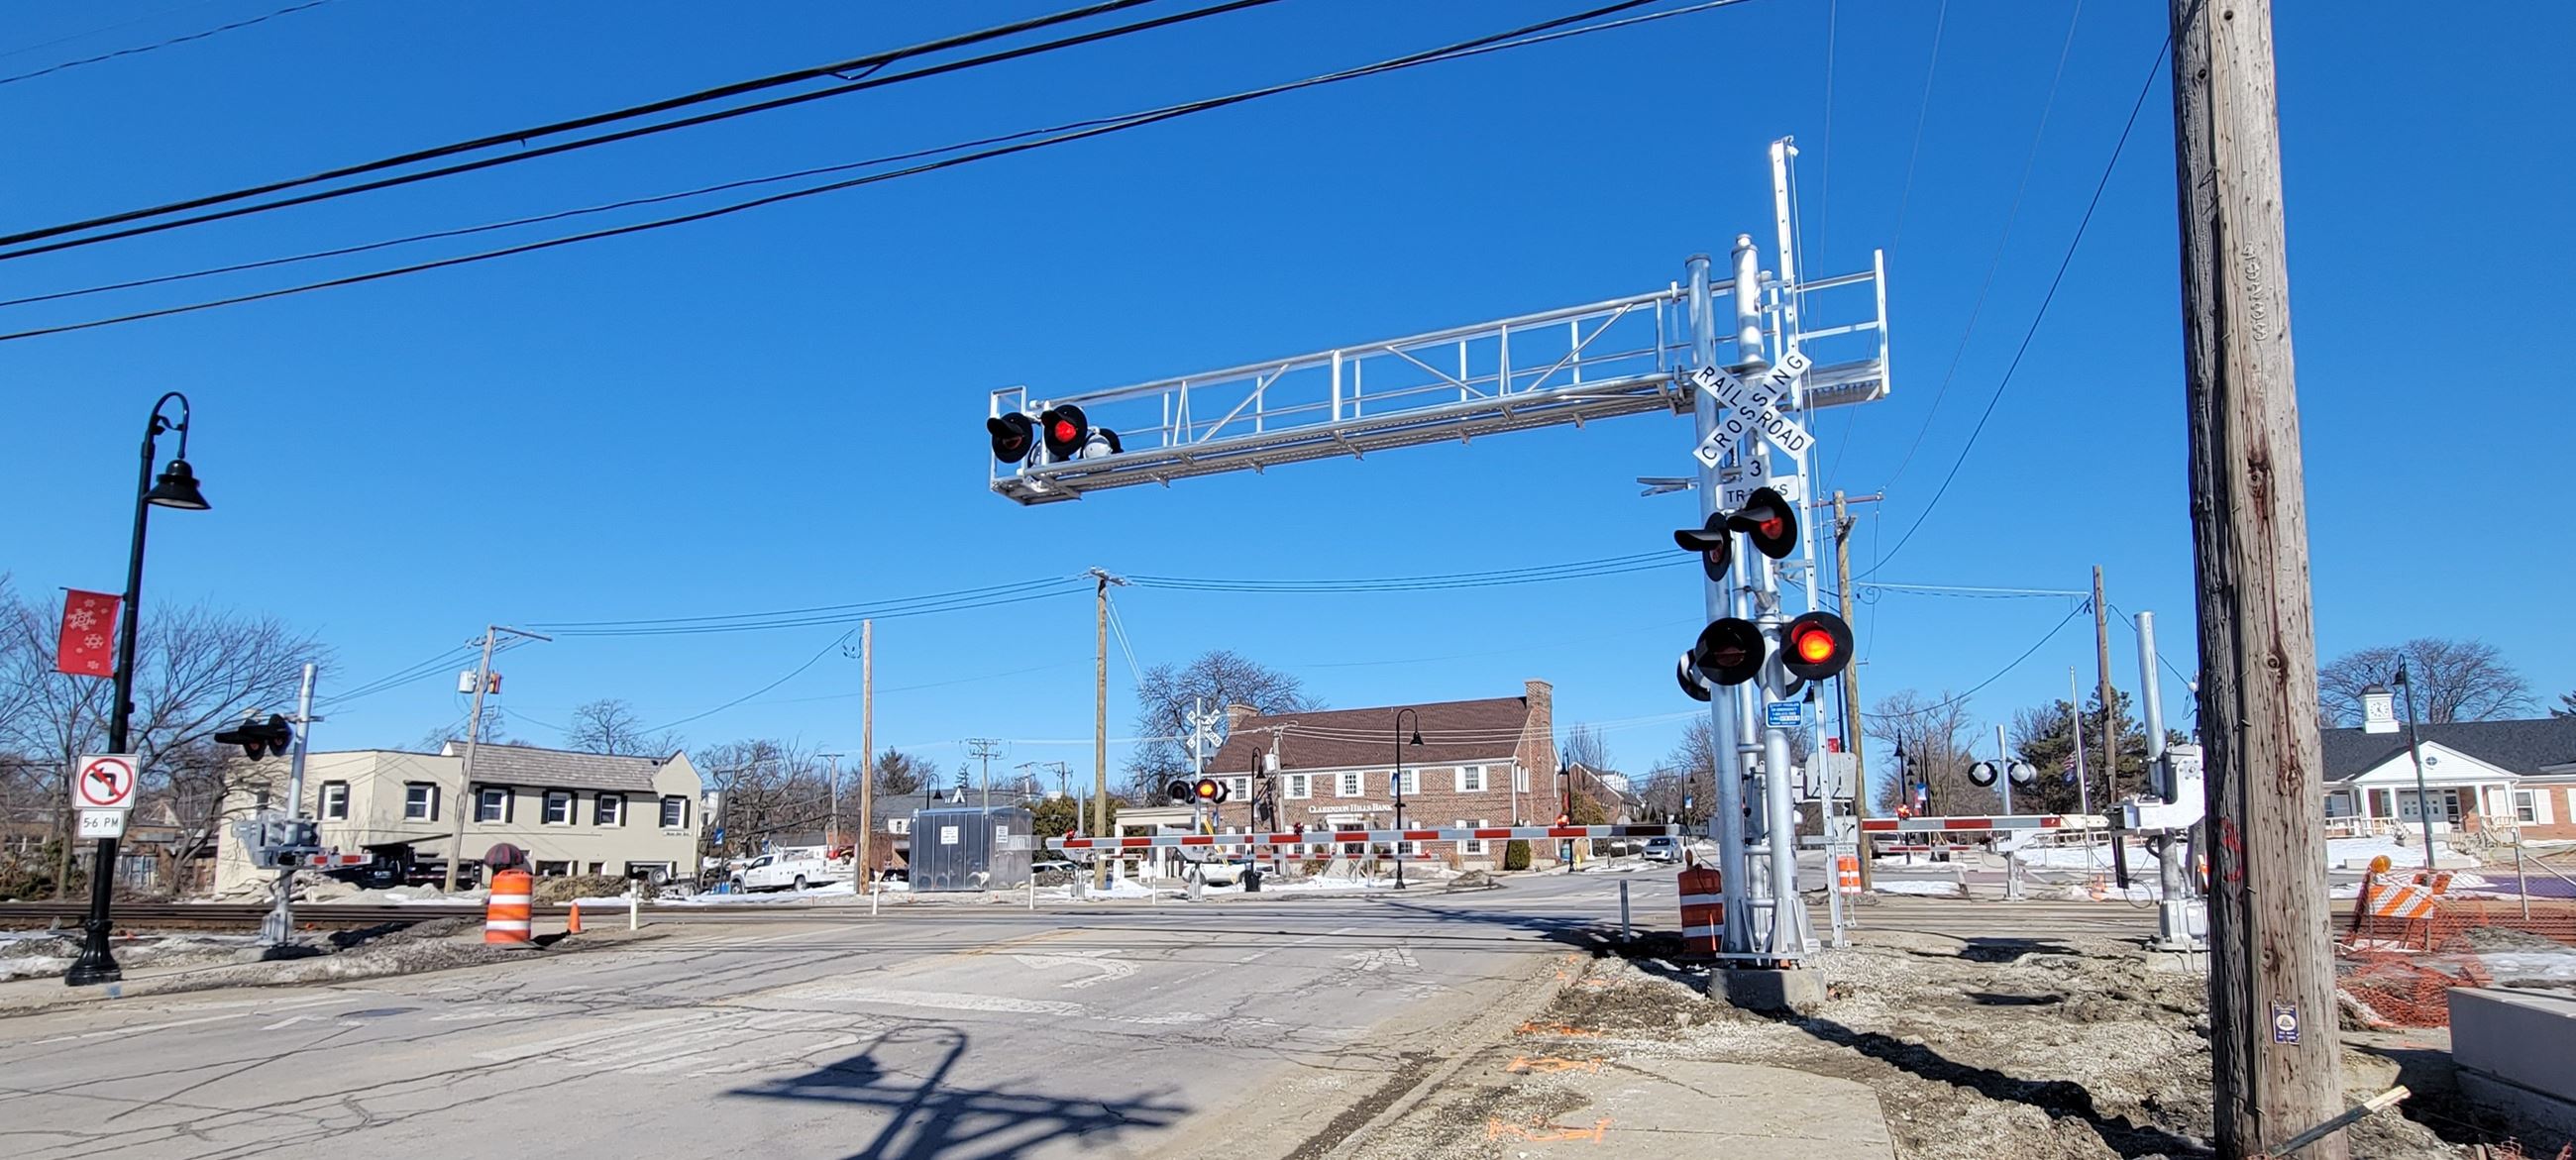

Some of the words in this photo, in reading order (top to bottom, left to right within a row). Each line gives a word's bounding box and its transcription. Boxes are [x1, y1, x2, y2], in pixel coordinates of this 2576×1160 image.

[1701, 355, 1803, 460] CROSSING
[1750, 460, 1762, 476] 3
[104, 817, 119, 827] PM
